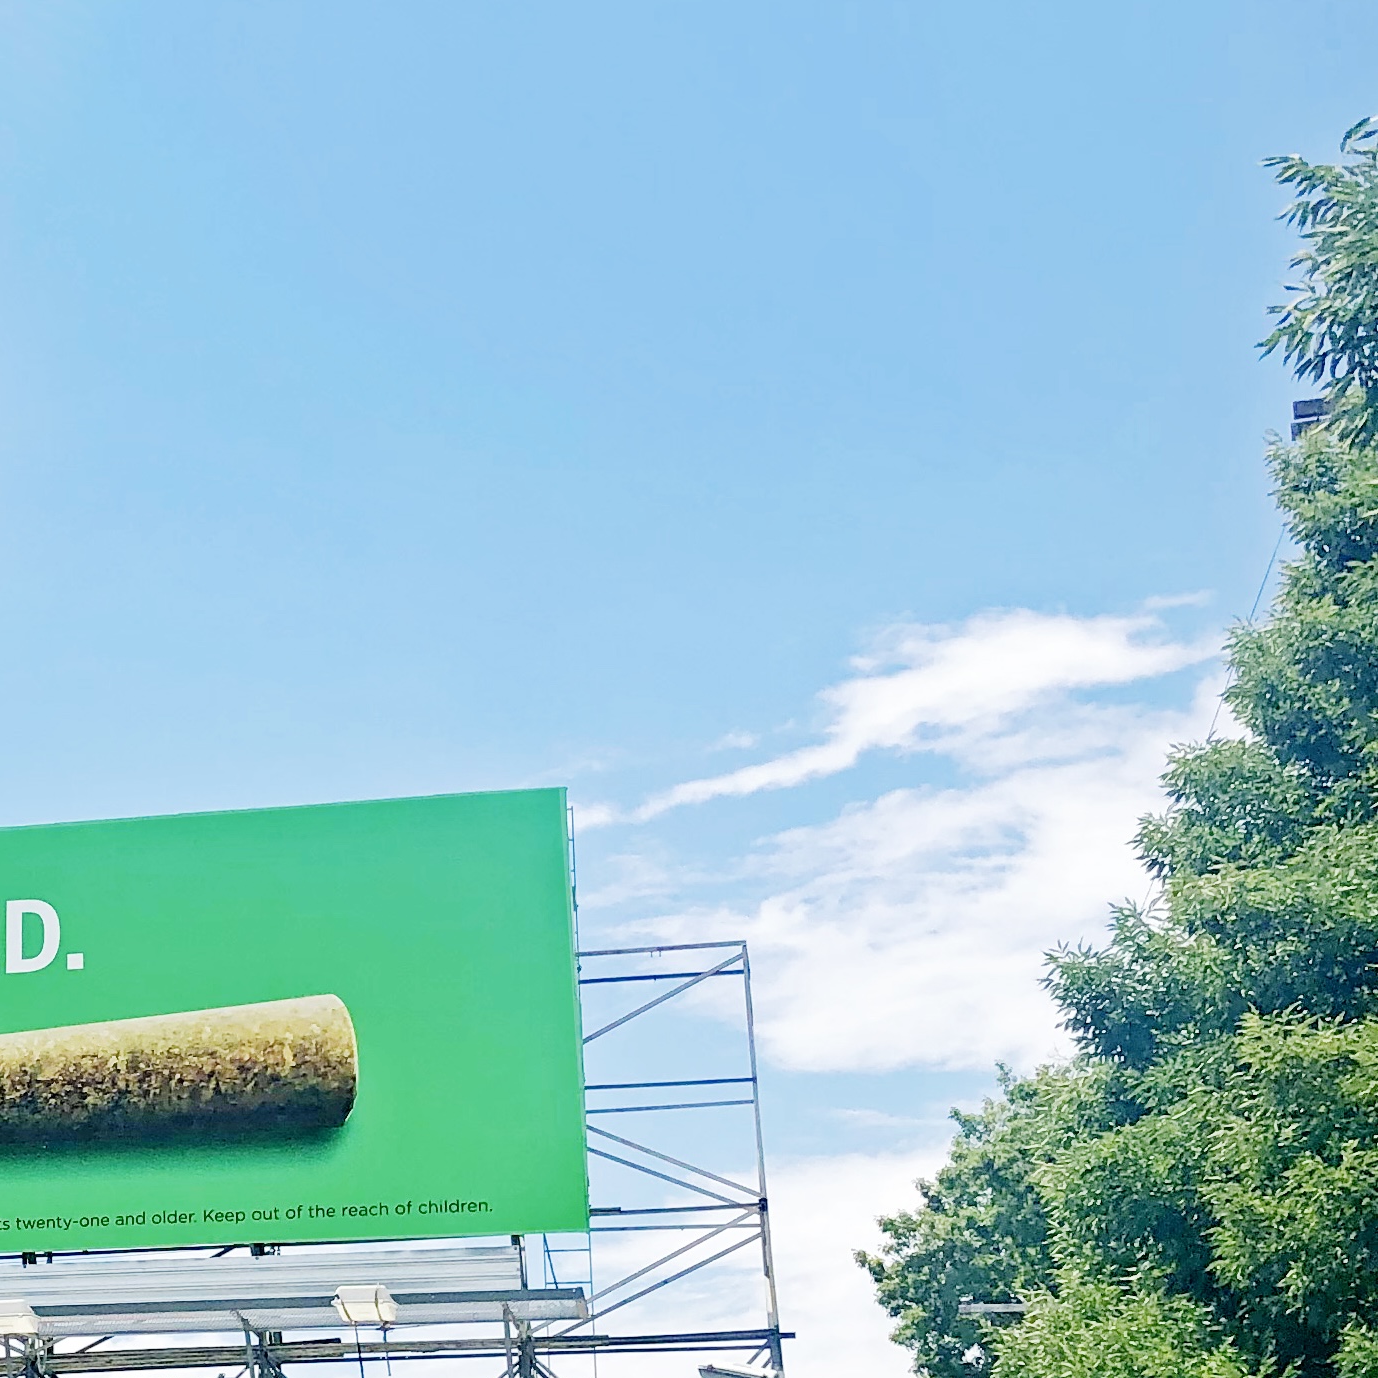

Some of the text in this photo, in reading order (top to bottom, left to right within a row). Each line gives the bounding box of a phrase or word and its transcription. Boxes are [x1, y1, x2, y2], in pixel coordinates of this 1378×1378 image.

[15, 1216, 110, 1231] twenty-one
[114, 1210, 146, 1226] and
[151, 1209, 197, 1225] older.
[203, 1208, 246, 1225] Keep
[251, 1206, 280, 1221] out
[285, 1204, 304, 1220] of
[307, 1204, 336, 1219] the
[341, 1201, 389, 1217] reach
[394, 1200, 413, 1216] of
[418, 1199, 493, 1215] children.
